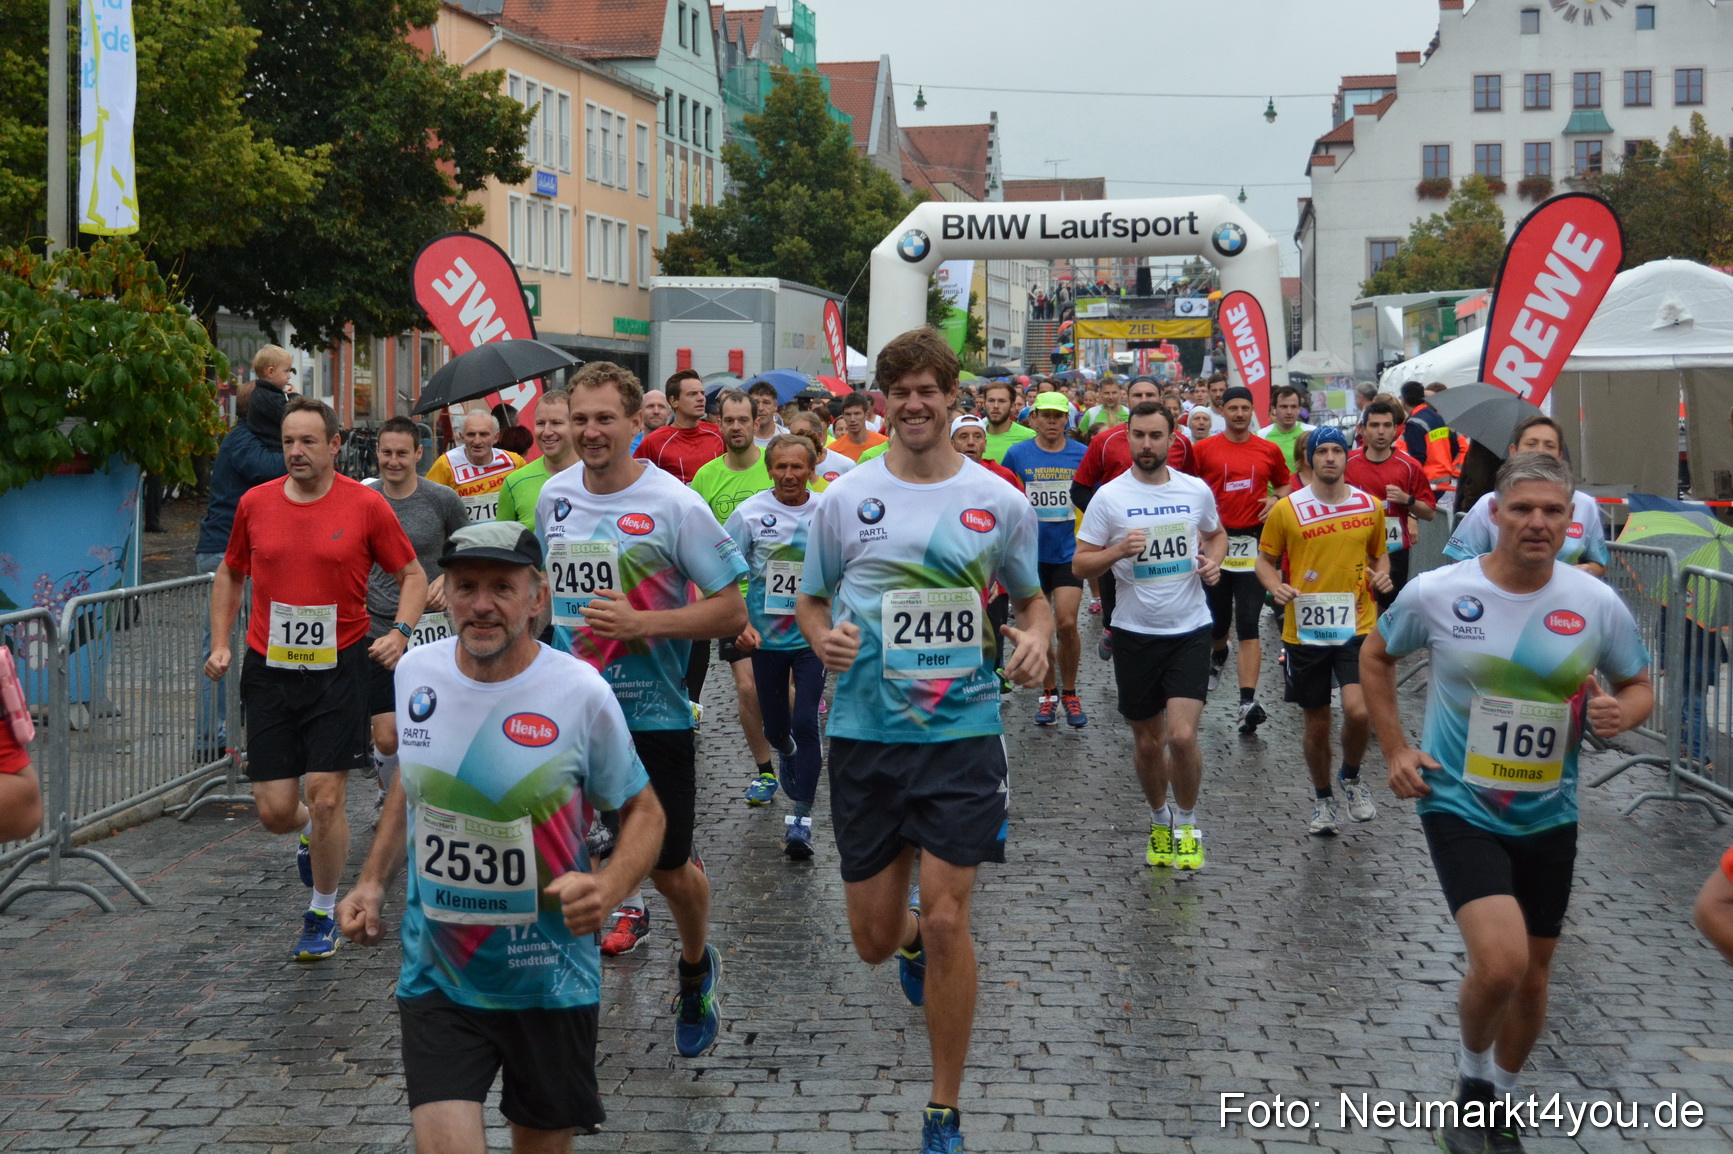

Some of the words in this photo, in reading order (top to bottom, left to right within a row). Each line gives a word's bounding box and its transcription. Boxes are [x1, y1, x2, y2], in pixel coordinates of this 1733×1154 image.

[942, 214, 1031, 240] BMW
[1040, 211, 1199, 243] Laufsport
[1493, 222, 1604, 399] REWE
[1129, 324, 1159, 335] ZIEL
[1035, 467, 1077, 475] NEUMARKTE
[459, 484, 485, 498] MAX
[488, 475, 504, 489] BÖ
[1030, 491, 1067, 506] 3056
[1127, 505, 1190, 517] PUMA
[621, 517, 650, 529] Hervis
[966, 513, 991, 526] Hervis
[859, 528, 887, 537] PARTL
[1302, 524, 1337, 540] MAX
[1341, 517, 1375, 530] BÖGL
[860, 535, 888, 544] Neumarkt
[570, 543, 610, 554] BOCK
[1137, 536, 1188, 562] 2446
[1148, 564, 1179, 575] Manuel
[552, 561, 613, 593] 2439
[785, 599, 796, 608] Jo
[927, 591, 974, 603] BOCK
[1302, 605, 1349, 626] 2817
[1550, 616, 1580, 629] Hervis
[281, 621, 324, 645] 129
[894, 610, 974, 644] 2448
[1453, 626, 1485, 635] PARTL
[1314, 630, 1337, 639] Stefan
[287, 651, 315, 661] Bernd
[917, 653, 950, 666] Peter
[608, 664, 626, 679] 17.
[610, 680, 653, 689] eumarkter
[1480, 705, 1513, 715] NeuerMarkt
[1520, 705, 1568, 719] BOCK
[403, 728, 431, 739] PARTL
[510, 719, 552, 738] Hervis
[402, 739, 430, 747] Neumarkt
[1492, 722, 1556, 758] 169
[1492, 763, 1543, 779] Thomas
[424, 816, 457, 831] NeuerMarkt
[465, 819, 523, 839] BOCK
[425, 834, 525, 886] 2530
[436, 888, 507, 910] Klemens
[507, 924, 538, 941] 17.
[508, 953, 561, 968] Stadtlauf
